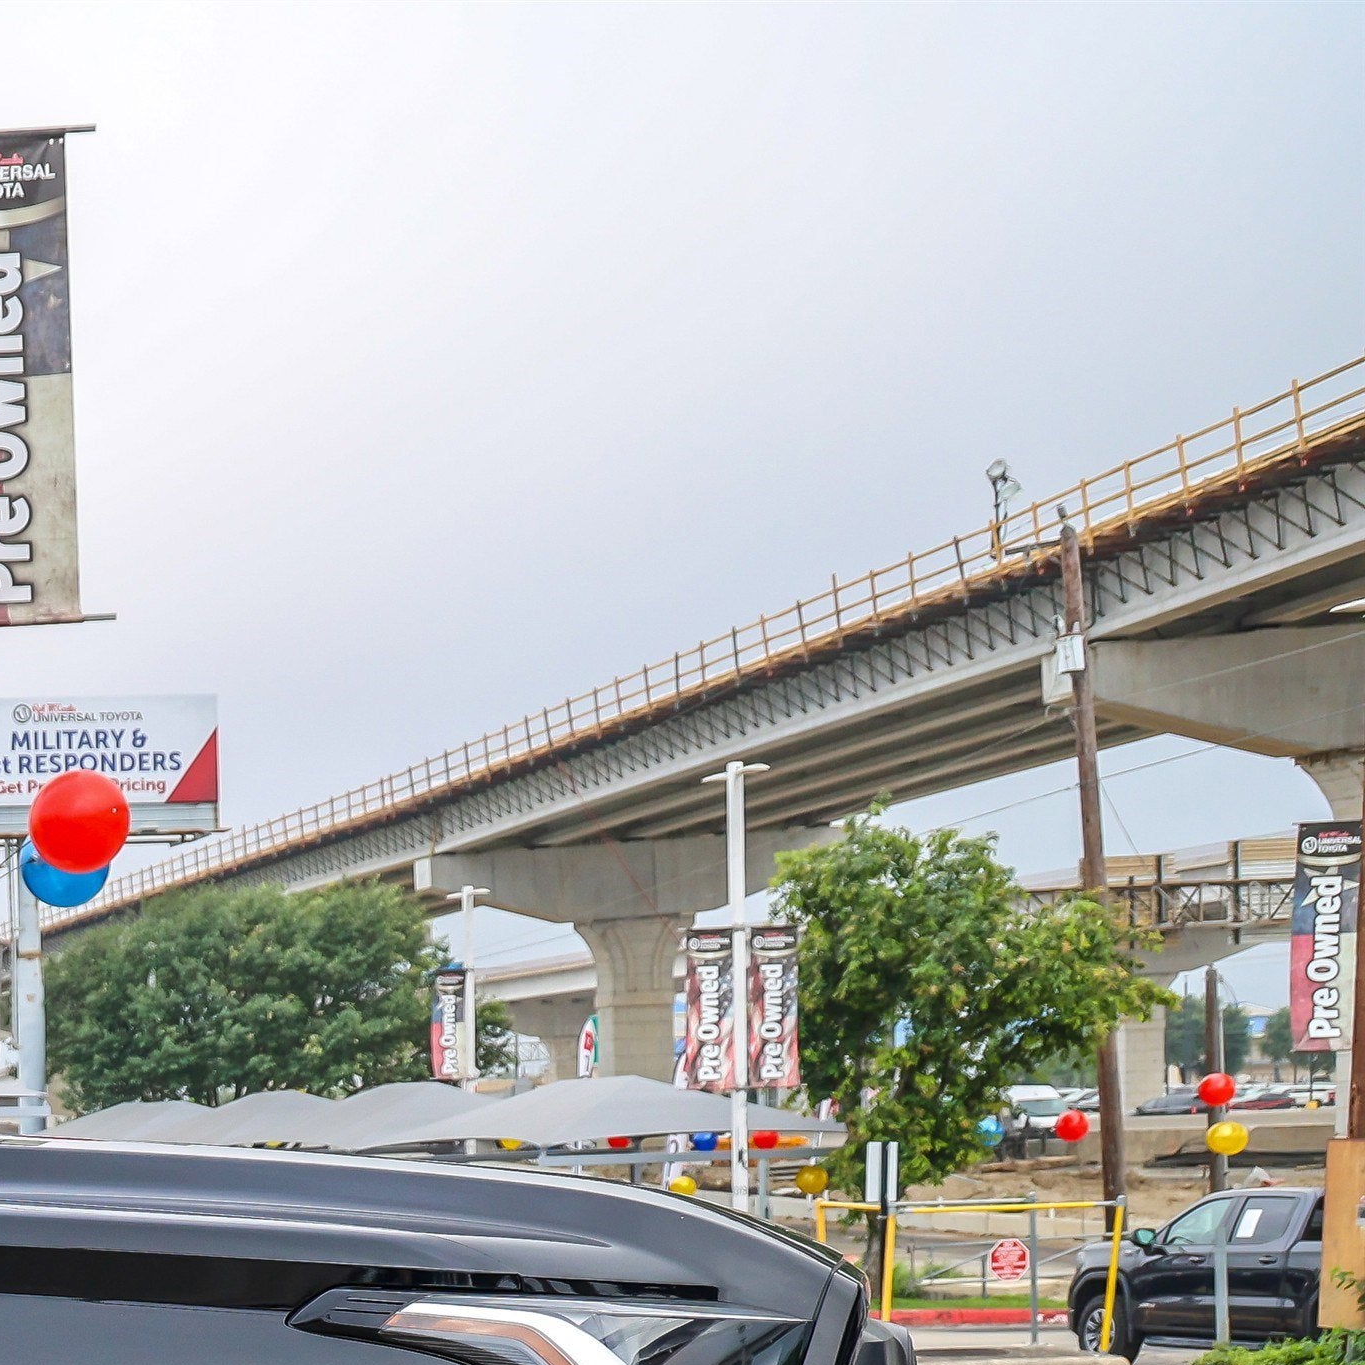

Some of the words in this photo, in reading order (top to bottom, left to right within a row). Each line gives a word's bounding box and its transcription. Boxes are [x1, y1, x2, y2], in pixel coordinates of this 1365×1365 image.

[33, 712, 96, 722] UNIVERSAL
[99, 711, 143, 721] TOYOTA
[11, 728, 126, 751] MILITARY
[132, 728, 147, 748] &
[19, 751, 183, 774] RESPONDERS
[1306, 875, 1343, 982] Owned
[696, 965, 720, 1040] Owned
[759, 964, 783, 1038] Owned
[1308, 987, 1342, 1039] Pre
[440, 994, 456, 1048] Owned
[443, 1048, 458, 1075] Pre
[698, 1042, 721, 1081] Pre
[760, 1042, 784, 1079] Pre
